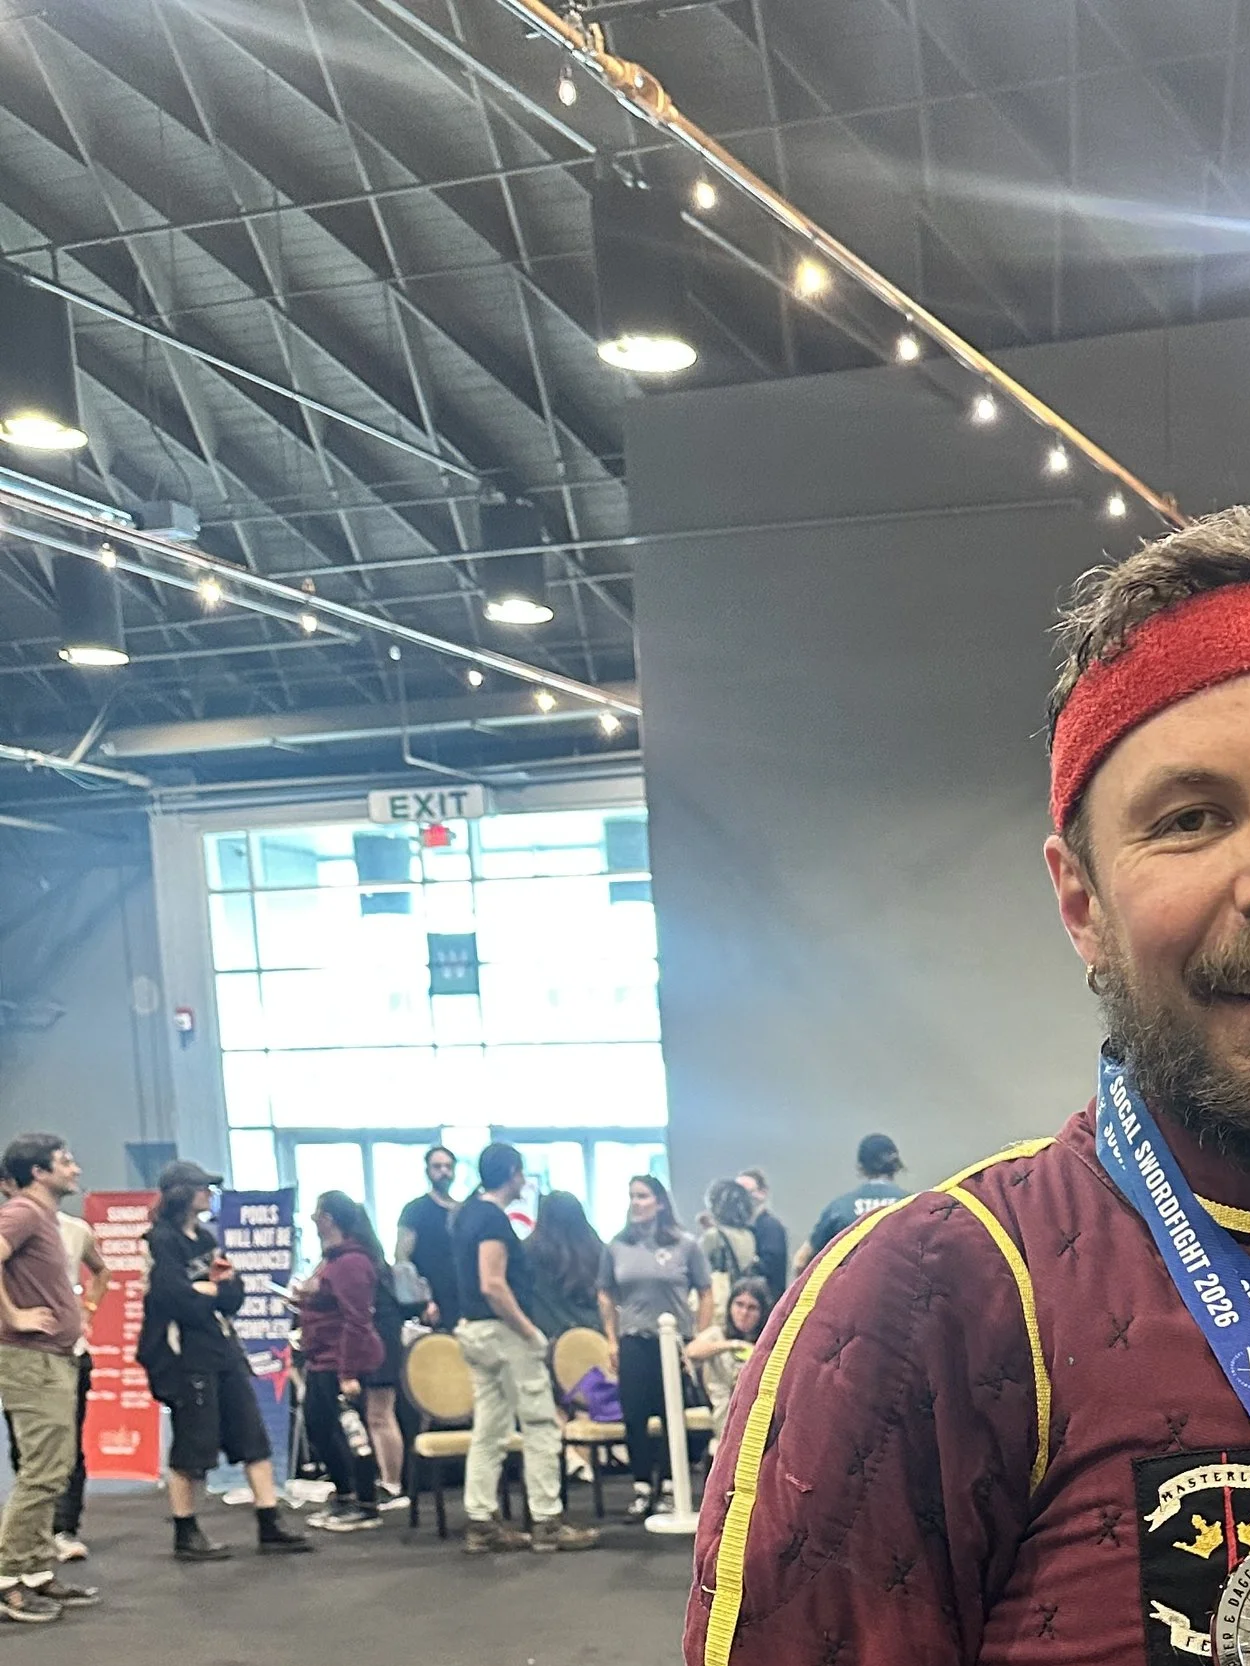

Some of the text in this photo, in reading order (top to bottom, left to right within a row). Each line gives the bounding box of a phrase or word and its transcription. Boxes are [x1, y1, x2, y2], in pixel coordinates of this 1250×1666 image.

[390, 791, 468, 819] EXIT
[1110, 1075, 1240, 1328] SOCAL SWORDFIGHT 2026
